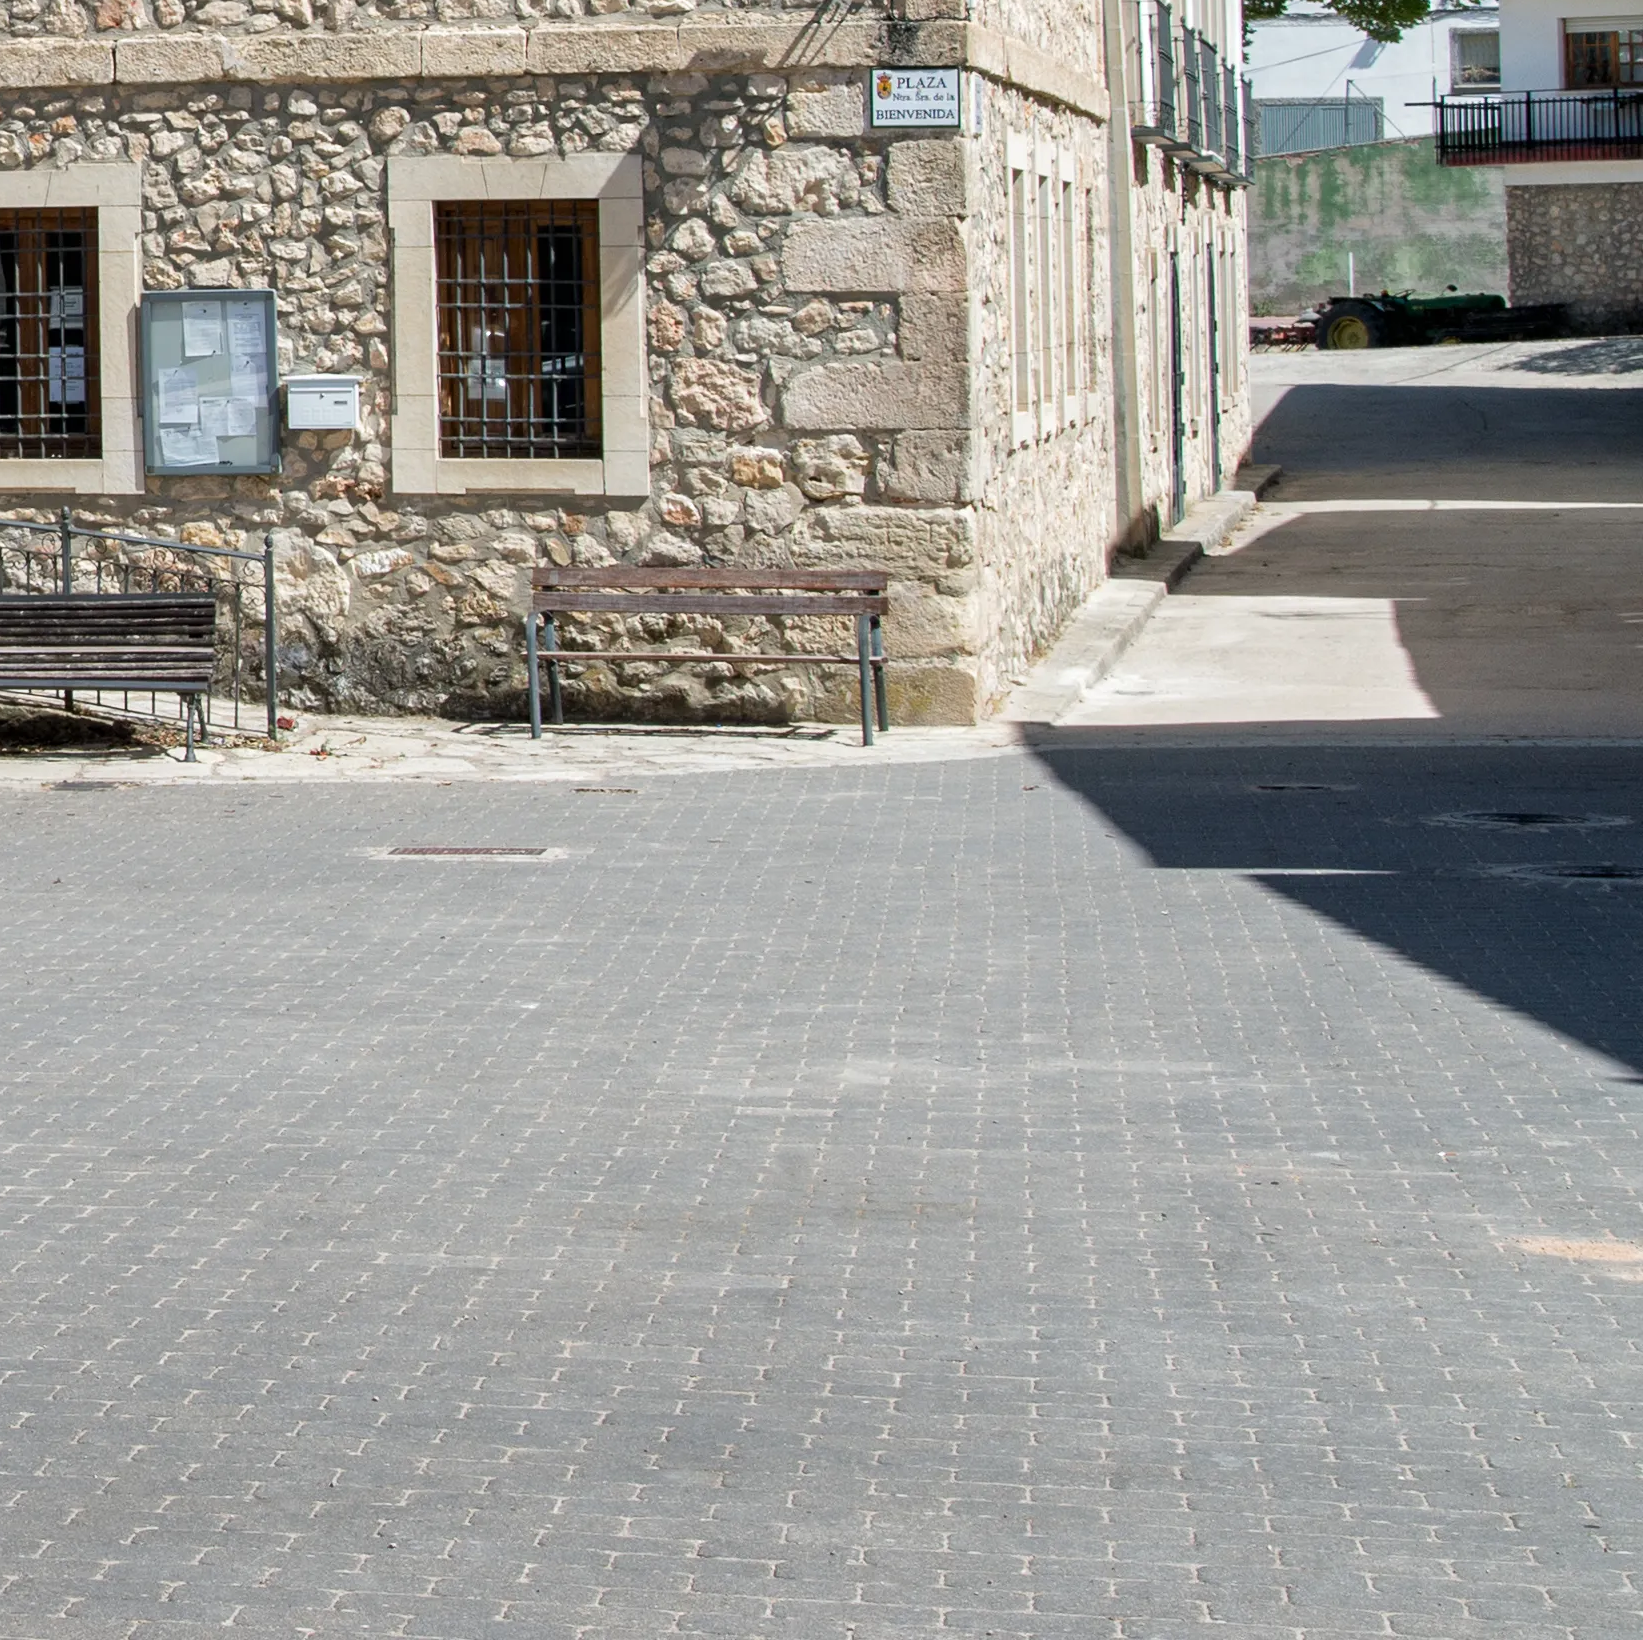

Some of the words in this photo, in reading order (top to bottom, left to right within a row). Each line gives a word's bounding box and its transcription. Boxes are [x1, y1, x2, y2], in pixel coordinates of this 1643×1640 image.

[897, 76, 947, 89] PLAZA
[933, 92, 944, 101] de
[946, 92, 955, 101] la
[876, 108, 955, 120] BIENVENIDA
